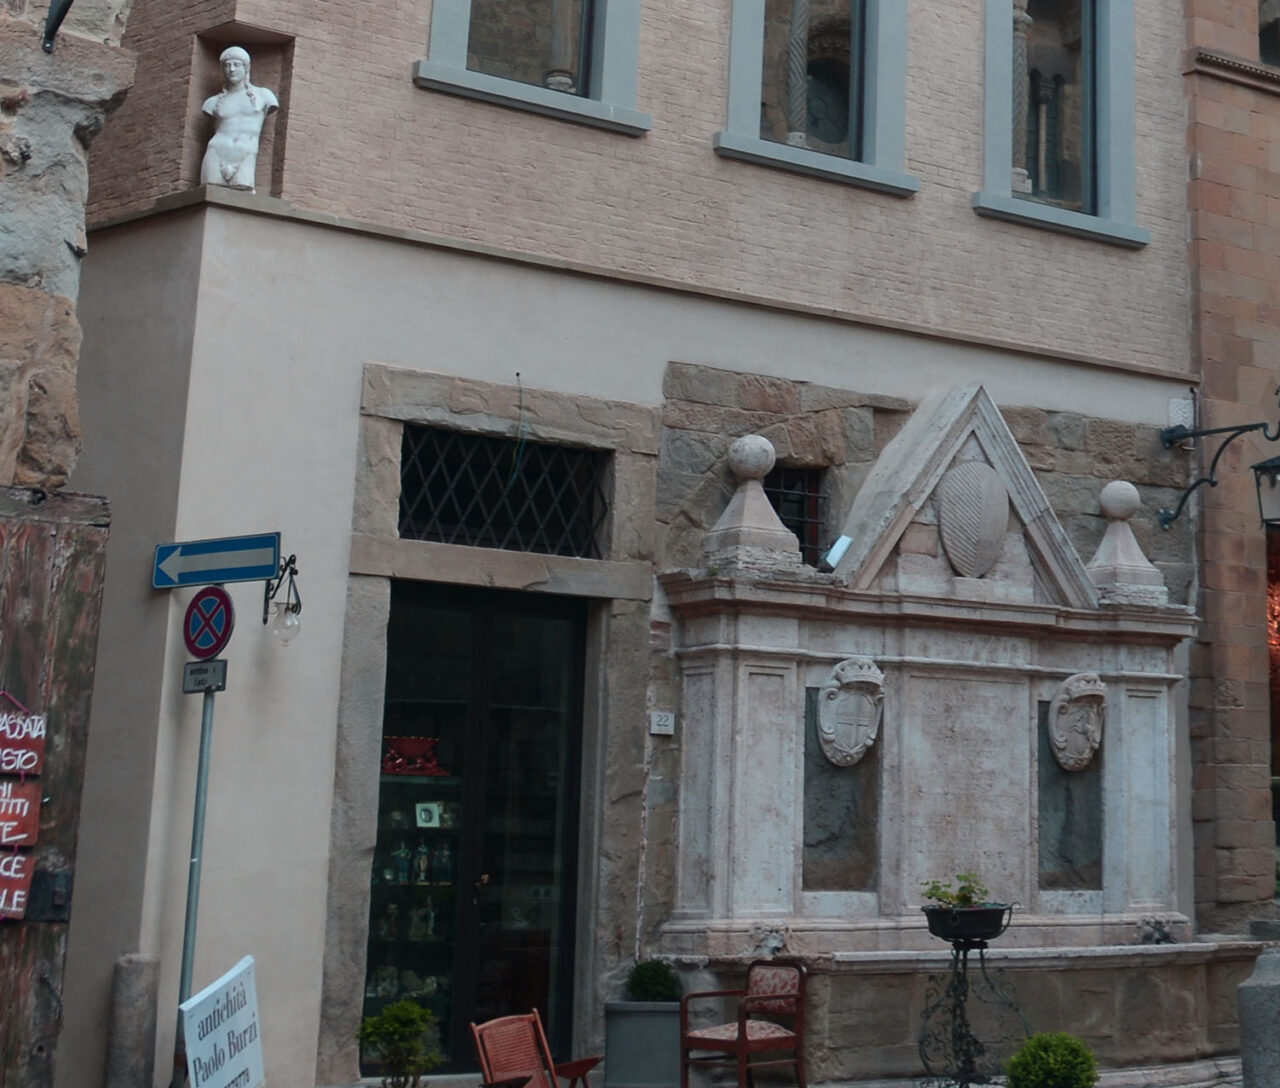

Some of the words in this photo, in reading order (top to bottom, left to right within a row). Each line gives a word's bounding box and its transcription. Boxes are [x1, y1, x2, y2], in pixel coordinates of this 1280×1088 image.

[656, 714, 669, 727] 22
[0, 748, 38, 770] STO
[198, 981, 247, 1041] antichità
[193, 1043, 225, 1088] Paolo
[227, 1012, 257, 1060] Burzi
